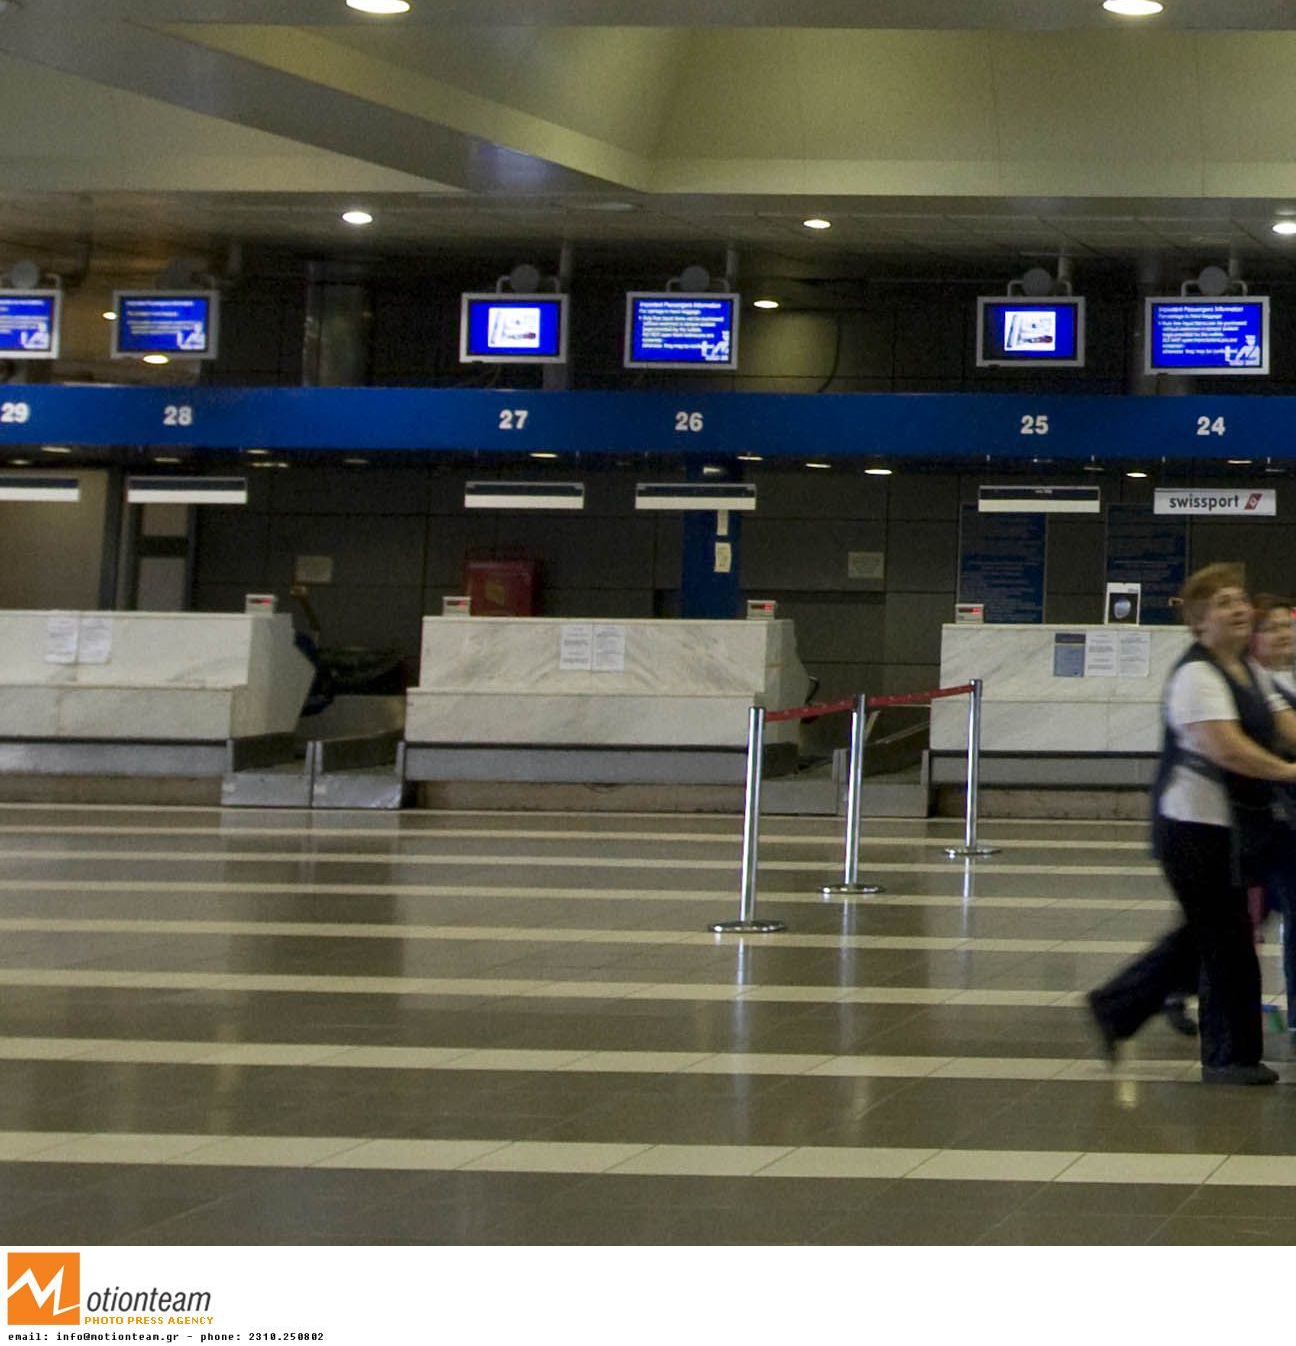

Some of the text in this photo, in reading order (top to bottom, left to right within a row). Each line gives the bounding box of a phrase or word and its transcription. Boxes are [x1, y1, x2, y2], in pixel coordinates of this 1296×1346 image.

[1, 402, 29, 423] 29
[163, 406, 192, 426] 28
[500, 410, 529, 431] 27
[675, 412, 704, 432] 26
[1021, 415, 1049, 435] 25
[1197, 416, 1226, 437] 24
[1169, 494, 1239, 511] swissport
